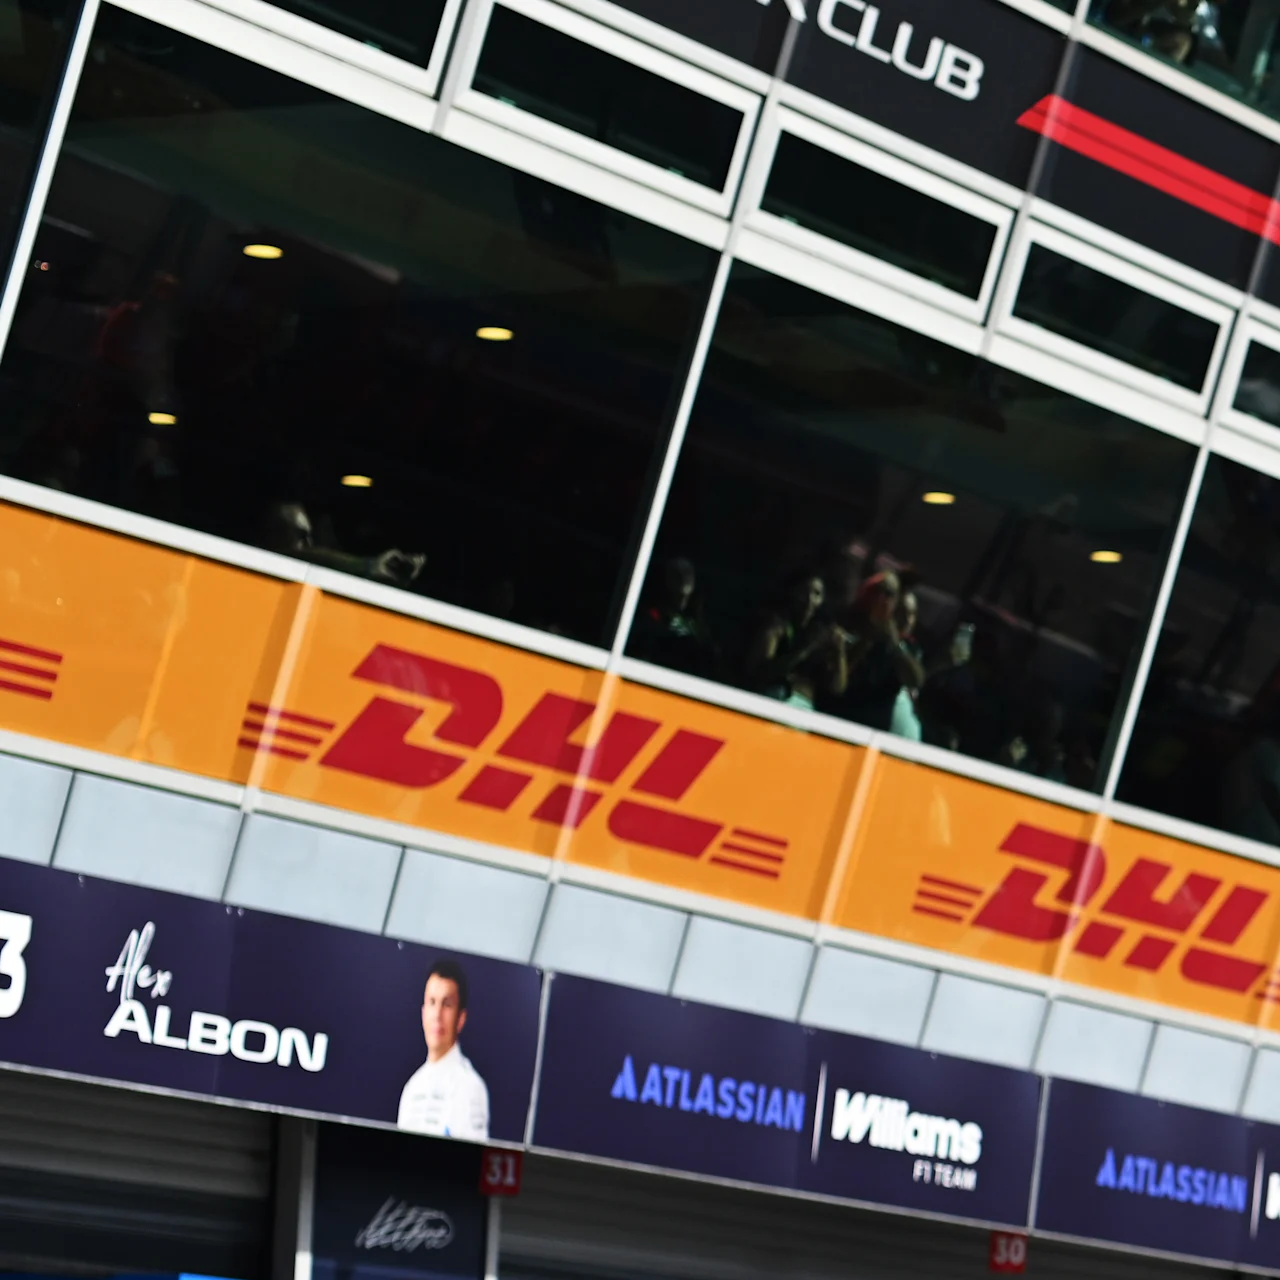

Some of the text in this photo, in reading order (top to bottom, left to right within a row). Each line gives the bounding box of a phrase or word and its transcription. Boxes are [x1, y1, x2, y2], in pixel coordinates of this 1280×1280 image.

[816, 0, 985, 101] CLUB
[320, 644, 725, 859] DHL
[972, 823, 1268, 993] DHL
[104, 999, 329, 1073] ALBON
[640, 1063, 807, 1134] ATLASSIAN
[830, 1087, 983, 1165] Williams
[485, 1155, 518, 1188] 31
[1119, 1154, 1248, 1214] ATLASSIAN
